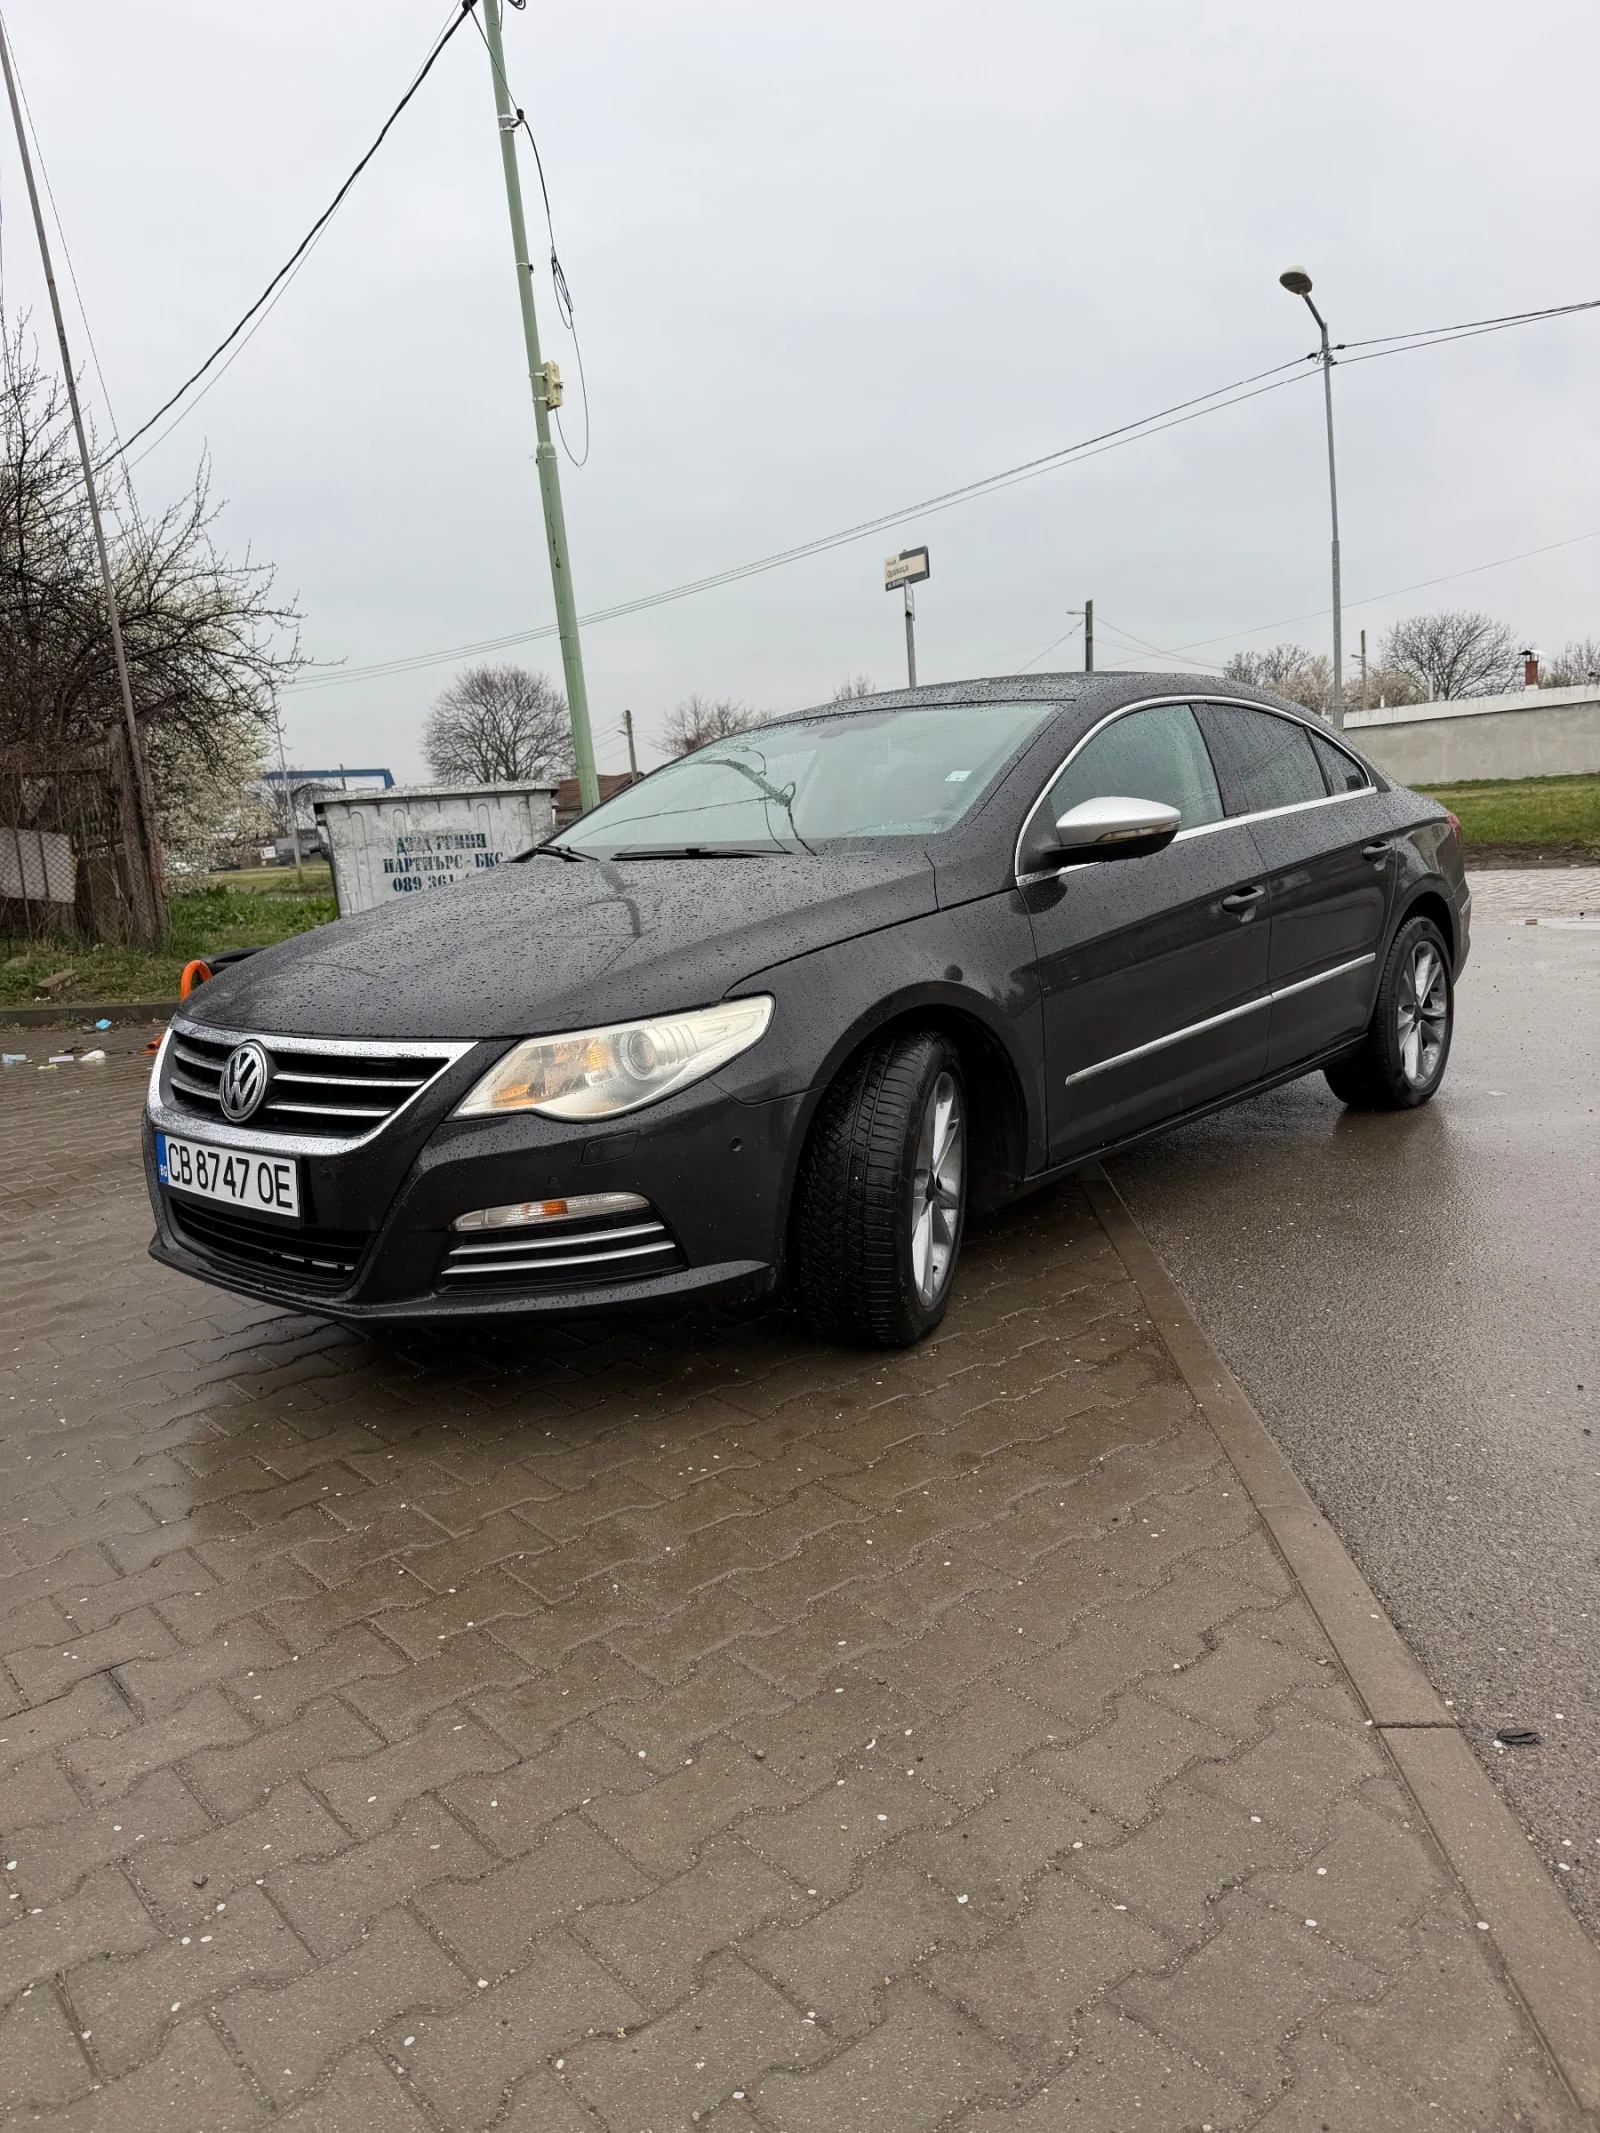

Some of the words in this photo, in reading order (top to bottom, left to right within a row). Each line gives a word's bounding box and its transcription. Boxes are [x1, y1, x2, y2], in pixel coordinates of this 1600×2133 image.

[382, 854, 463, 873] ПАРТНЪРС
[474, 852, 503, 868] БКС
[393, 876, 422, 892] 089
[160, 1164, 168, 1178] BG
[196, 1149, 250, 1199] 8747
